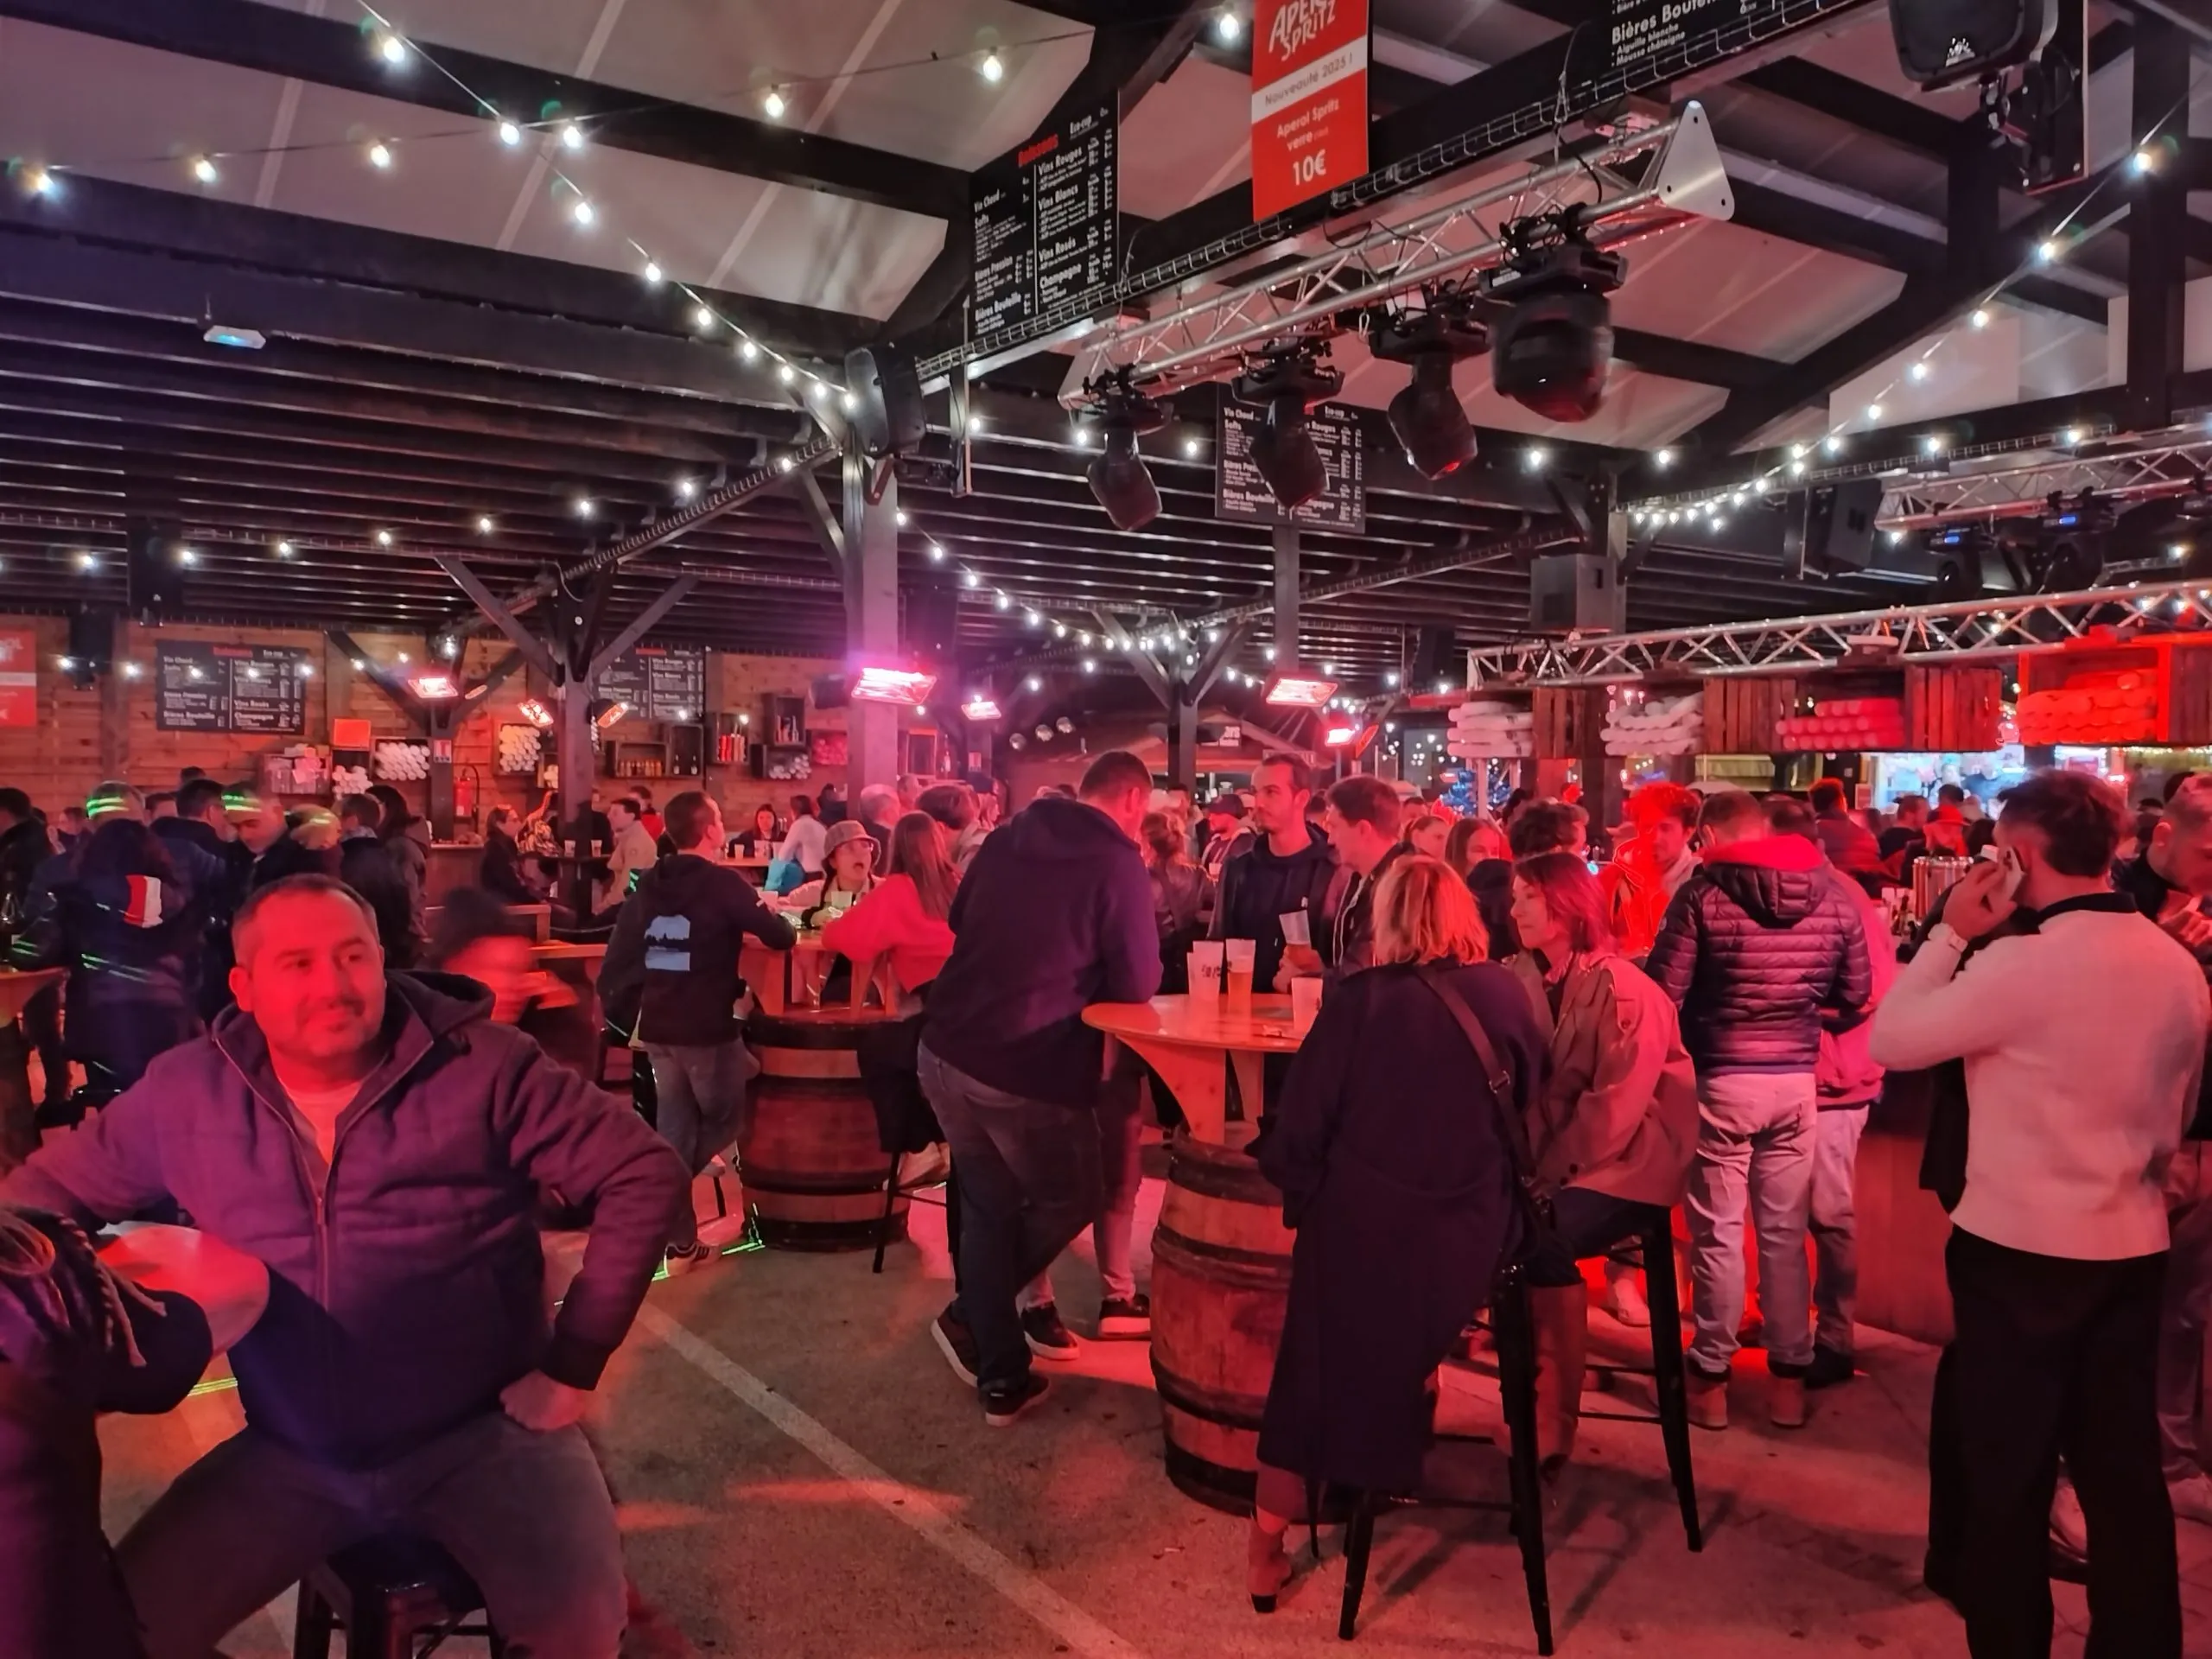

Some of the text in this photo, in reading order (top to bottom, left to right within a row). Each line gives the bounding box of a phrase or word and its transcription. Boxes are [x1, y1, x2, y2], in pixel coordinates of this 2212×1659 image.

[1611, 15, 1657, 45] Bières
[1617, 22, 1679, 54] Aiguille blanche
[1617, 48, 1646, 66] Mousse
[1265, 71, 1319, 106] Nouveauté
[1321, 56, 1347, 79] 2025
[1277, 111, 1310, 139] Aperol
[1312, 98, 1339, 122] Spritz
[1287, 130, 1313, 151] verre
[1038, 161, 1054, 177] Vins
[1055, 146, 1083, 168] Rouges
[1293, 148, 1327, 187] 10€
[1038, 196, 1054, 212] Vins
[1054, 184, 1079, 204] Blancs
[1039, 247, 1054, 263] Vins
[1039, 263, 1082, 289] Champagne
